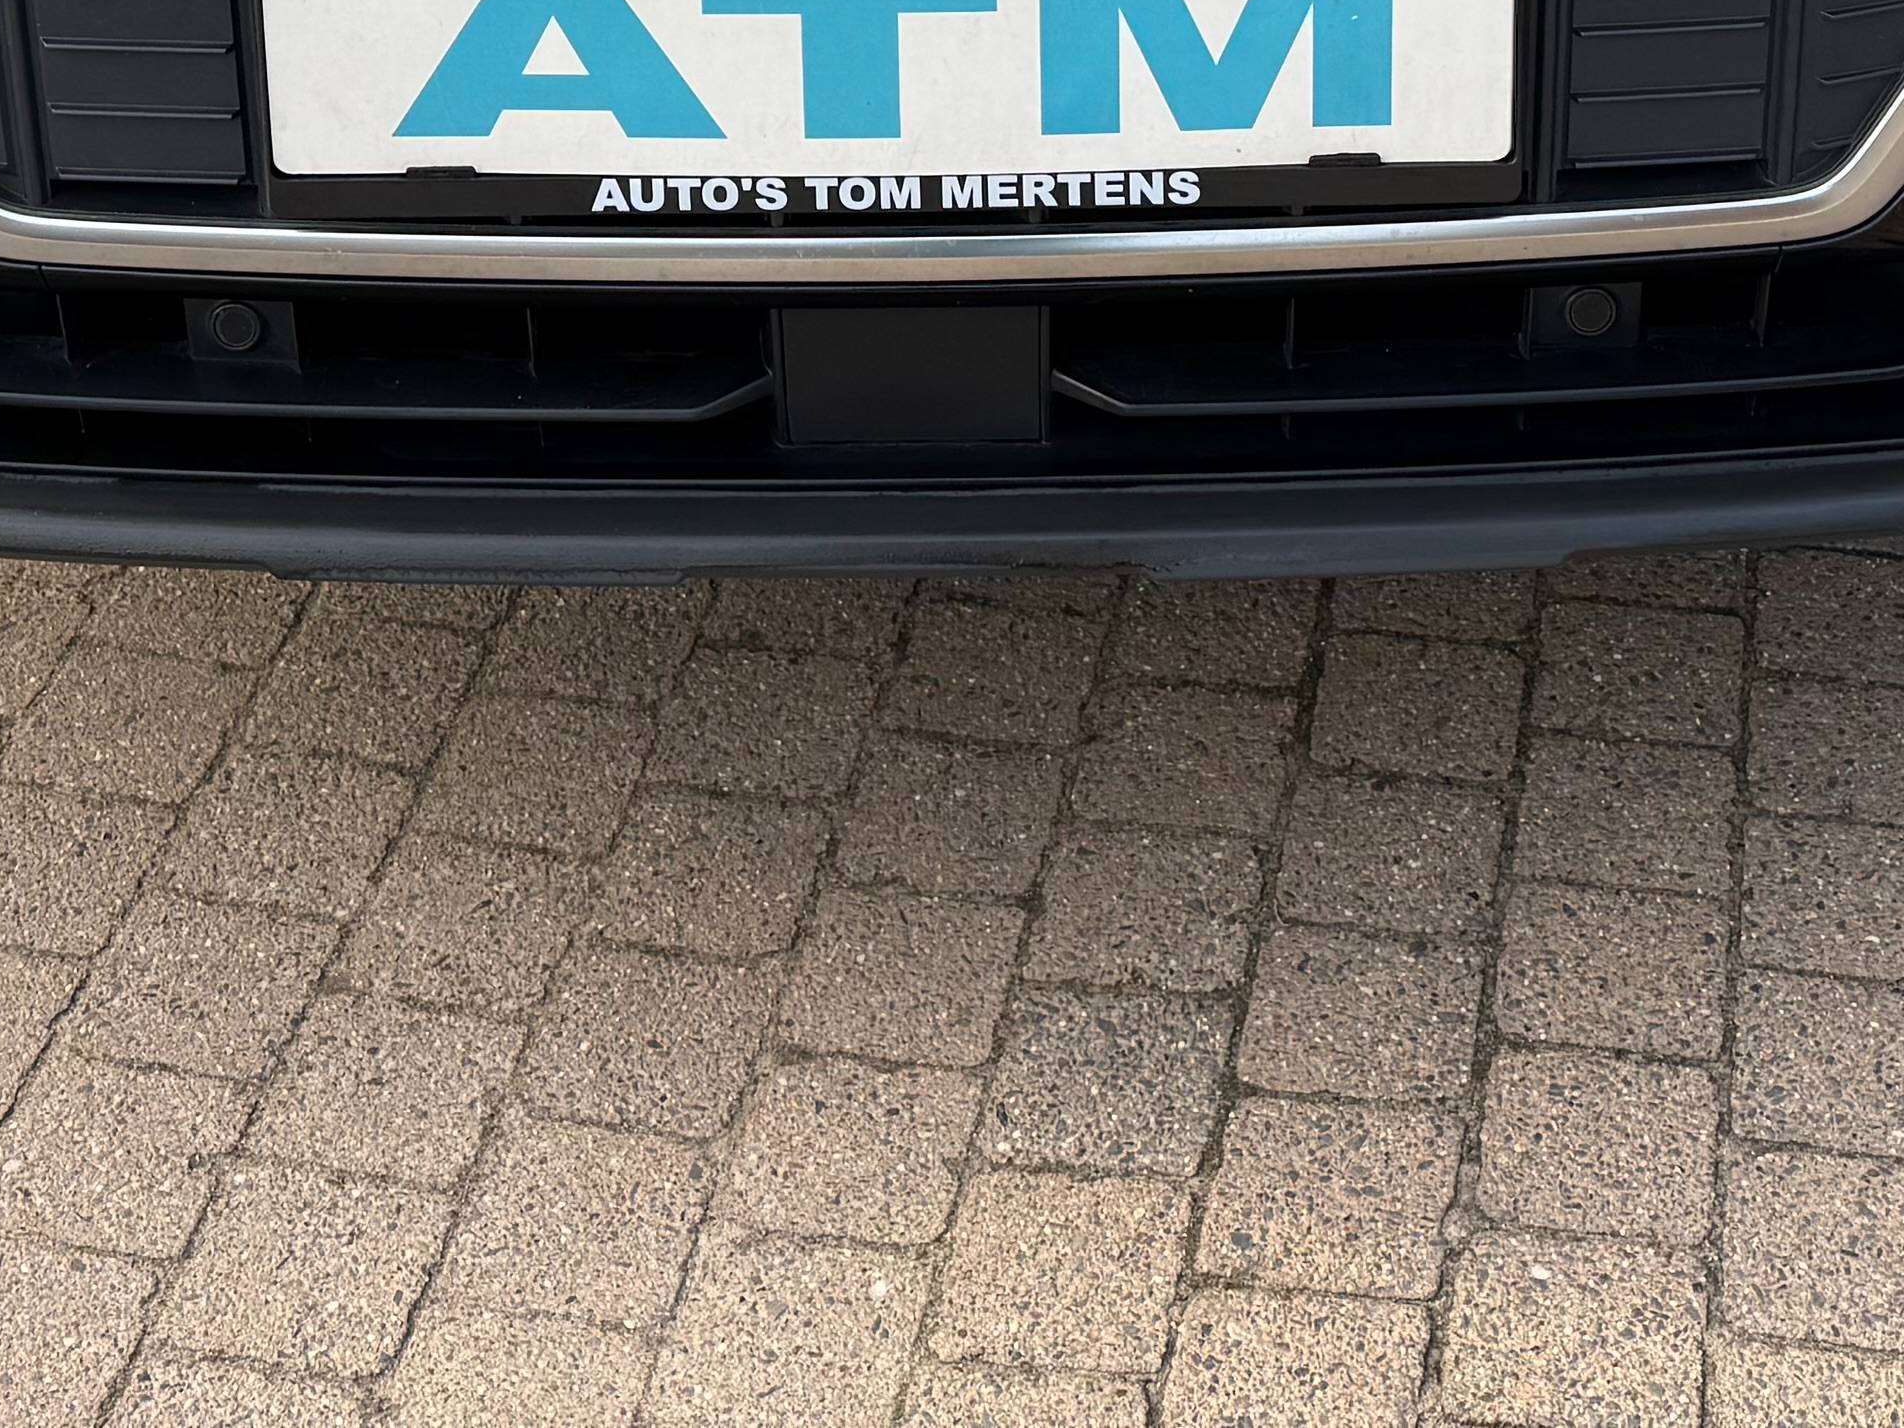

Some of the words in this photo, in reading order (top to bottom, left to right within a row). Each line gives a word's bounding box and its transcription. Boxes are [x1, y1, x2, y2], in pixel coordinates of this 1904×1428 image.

[592, 177, 788, 213] AUTO'S
[805, 176, 923, 211] TOM
[942, 171, 1201, 209] MERTENS
